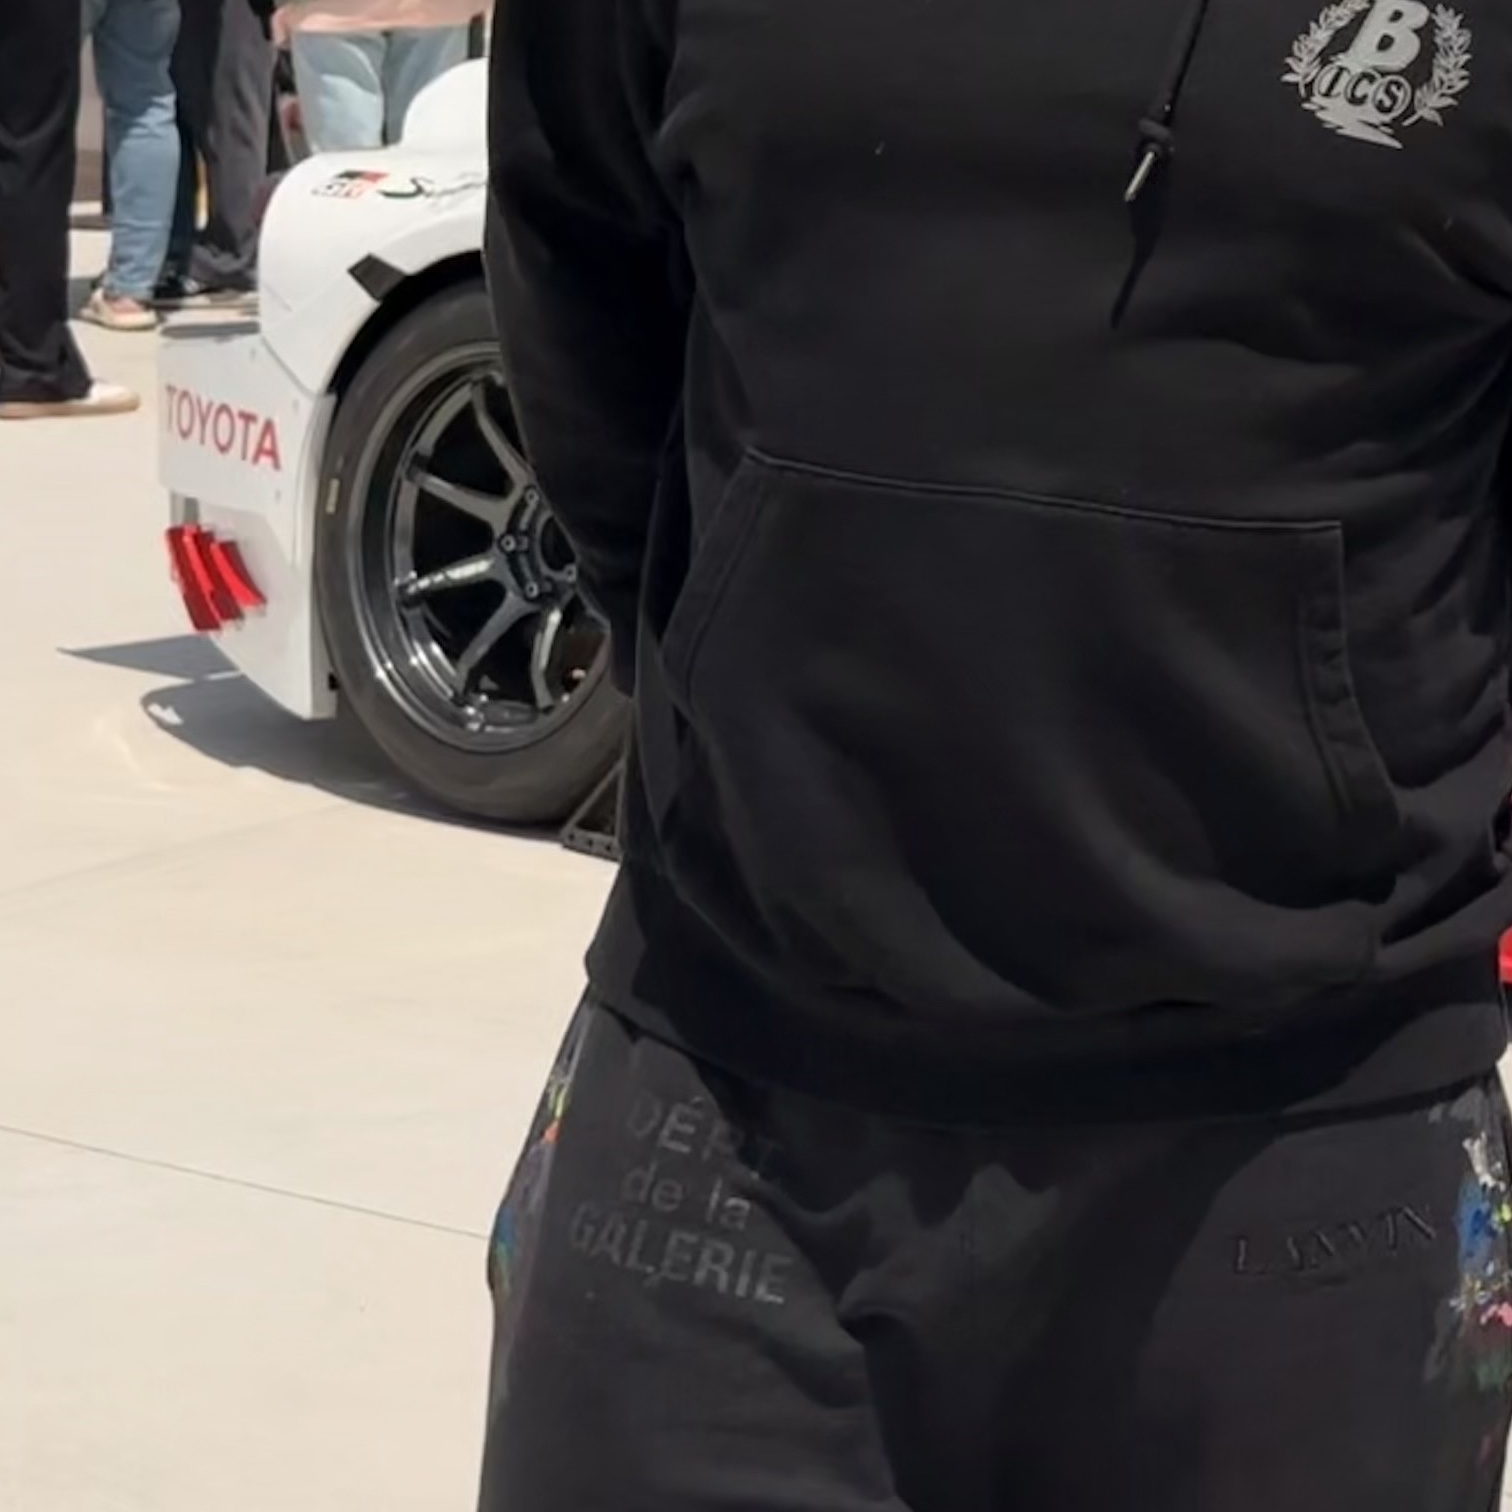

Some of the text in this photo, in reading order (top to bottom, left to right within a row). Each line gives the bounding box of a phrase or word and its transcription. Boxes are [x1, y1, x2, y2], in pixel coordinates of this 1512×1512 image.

[165, 383, 281, 471] TOYOTA
[620, 1159, 752, 1231] de la
[569, 1199, 793, 1305] GALERIE
